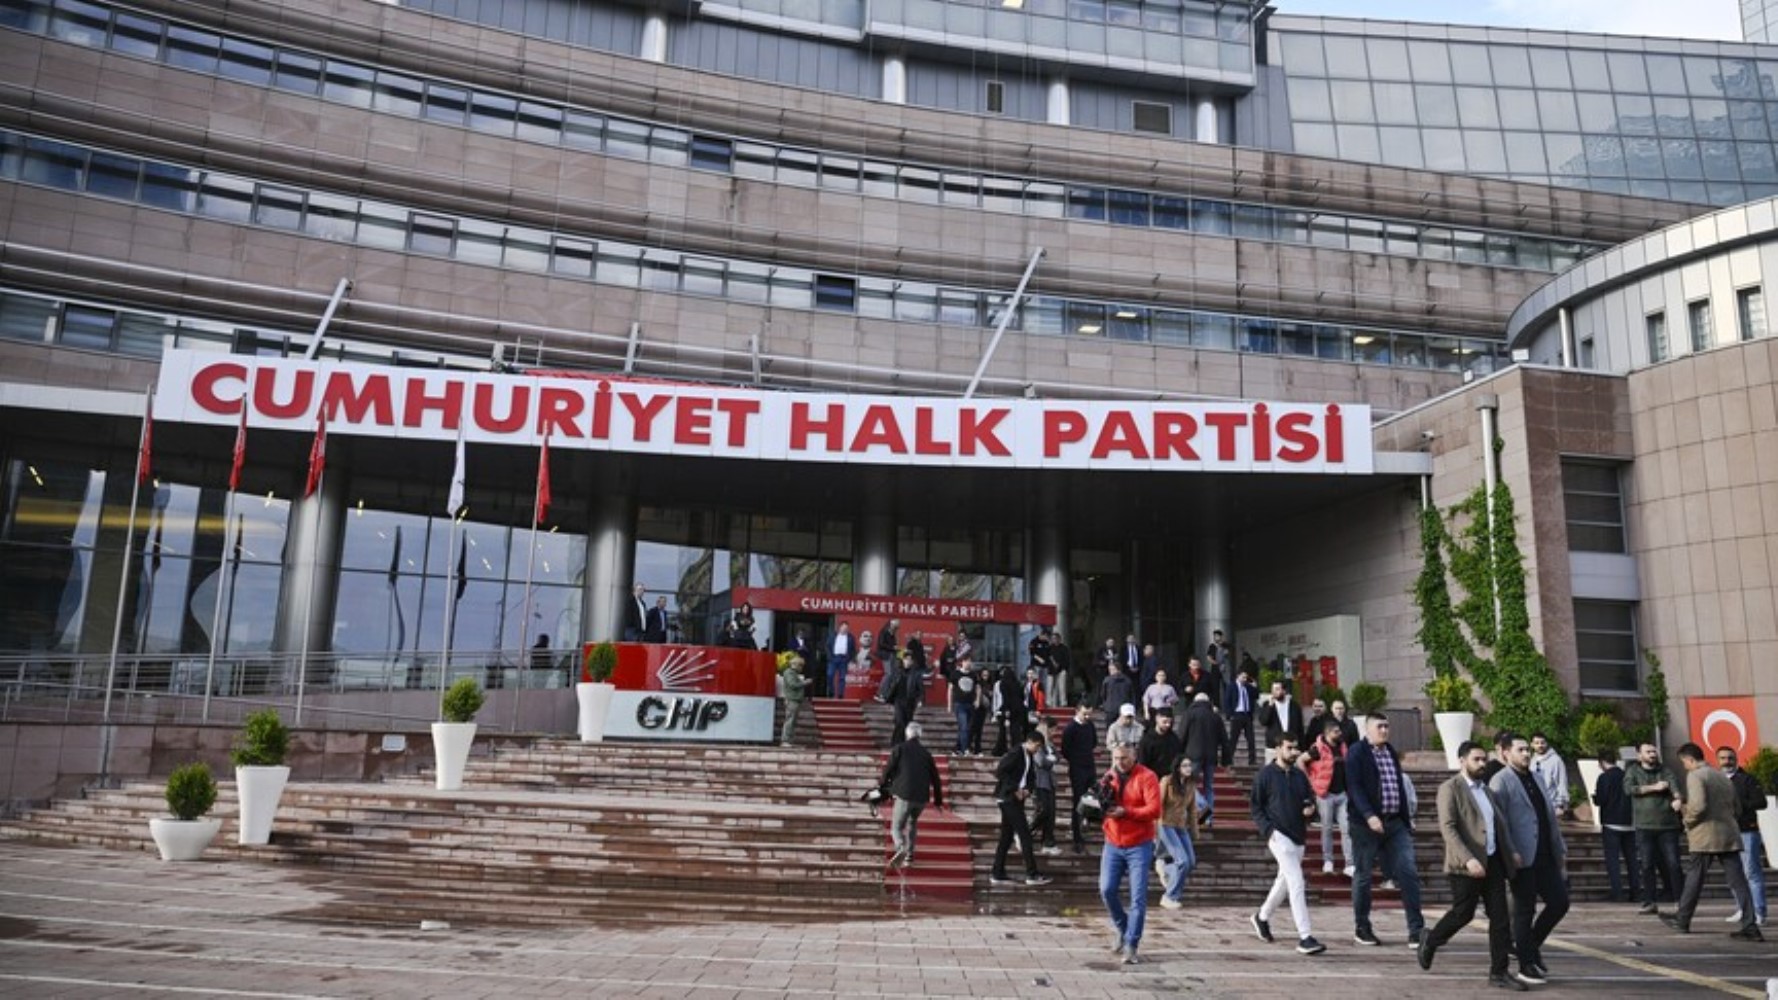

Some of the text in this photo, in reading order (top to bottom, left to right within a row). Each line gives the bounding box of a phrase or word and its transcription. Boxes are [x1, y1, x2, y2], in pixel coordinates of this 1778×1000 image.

[191, 363, 1344, 462] CUMHURİYET HALK PARTİSİ
[801, 597, 995, 618] CUMHURİYET HALK PARTİSİ
[637, 696, 728, 730] CHP
